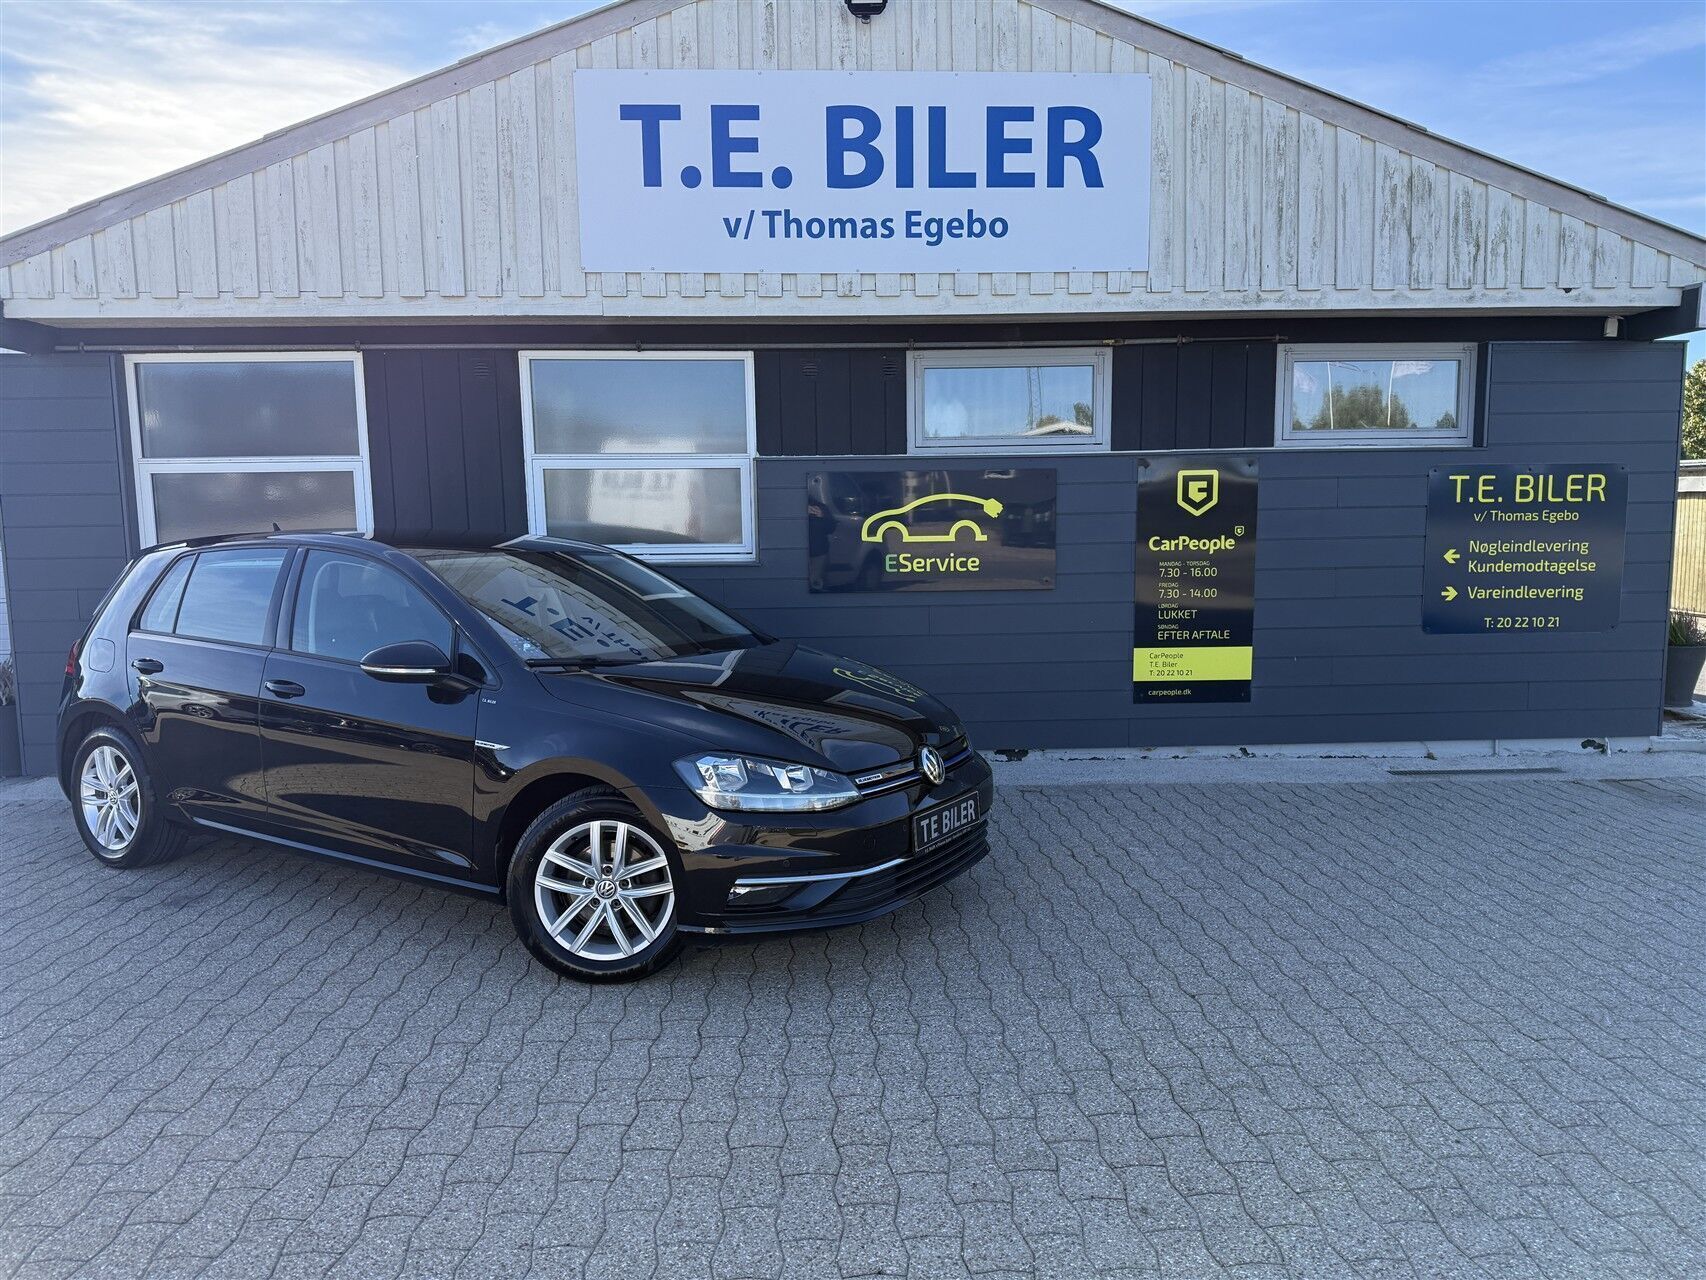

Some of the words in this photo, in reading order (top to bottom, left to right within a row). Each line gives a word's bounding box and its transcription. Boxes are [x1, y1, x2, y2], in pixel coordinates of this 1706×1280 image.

[619, 104, 793, 189] T.E.
[825, 105, 1105, 189] BILER
[722, 210, 755, 240] v/
[762, 210, 895, 240] Thomas
[904, 210, 1010, 246] Egebo
[1449, 475, 1503, 503] T.E.
[1515, 474, 1606, 503] BILER
[1474, 510, 1487, 523] v/
[1490, 510, 1539, 522] Thomas
[1542, 509, 1579, 523] Egebo
[1148, 535, 1236, 554] CarPeople
[1469, 539, 1589, 555] Nøgleindlevering
[885, 553, 980, 572] EService
[1468, 559, 1596, 575] Kundemodtagelse
[1159, 568, 1180, 578] 7.30
[1190, 567, 1218, 577] 16.00
[1158, 589, 1180, 599] 7.30
[1189, 588, 1218, 598] 14.00
[1467, 585, 1584, 600] Vareindlevering
[1158, 609, 1197, 620] LUKKET
[1484, 617, 1494, 628] T:
[1497, 617, 1511, 628] 20
[1515, 617, 1529, 628] 22
[1532, 617, 1545, 628] 10
[1547, 617, 1560, 628] 21
[1157, 631, 1189, 640] EFTER
[1191, 630, 1230, 640] AFTALE
[1148, 689, 1192, 697] carpeople.dk
[942, 799, 976, 834] BILER
